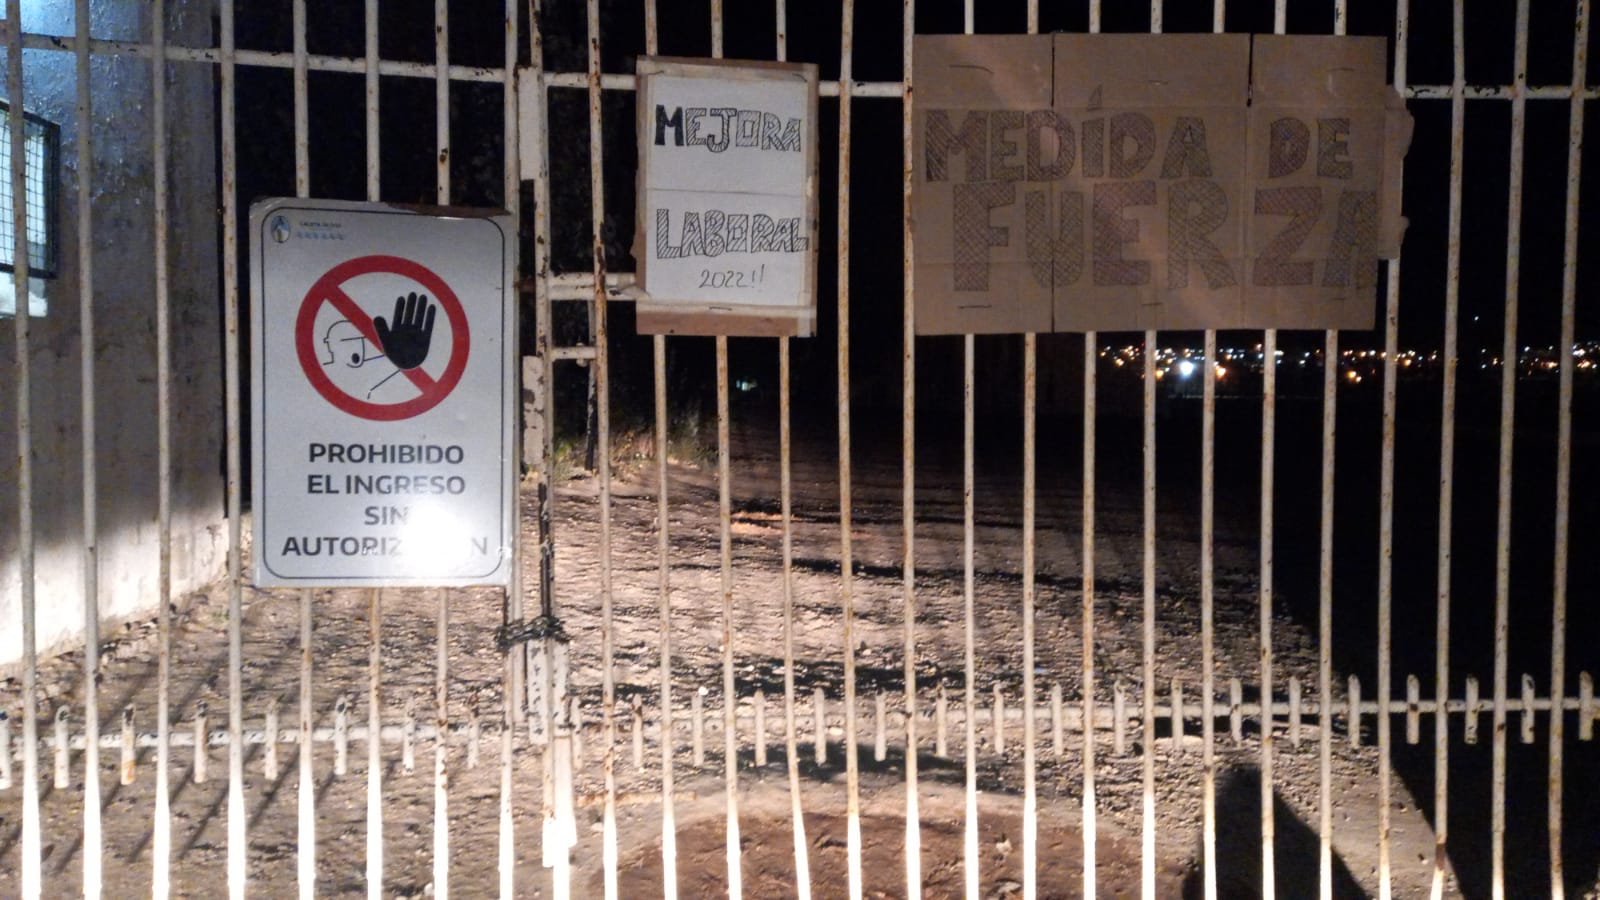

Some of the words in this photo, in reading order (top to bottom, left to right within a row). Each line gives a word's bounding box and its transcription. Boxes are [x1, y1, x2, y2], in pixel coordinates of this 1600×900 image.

[654, 104, 802, 153] MEJORA
[1269, 117, 1353, 179] DE
[656, 209, 809, 260] LABORAL
[953, 180, 1378, 291] FUERZA
[308, 443, 465, 465] PROHIBIDO
[307, 474, 340, 494] EL
[345, 475, 466, 495] INGRESO
[364, 506, 409, 526] SIN
[281, 536, 489, 557] AUTORIZN
